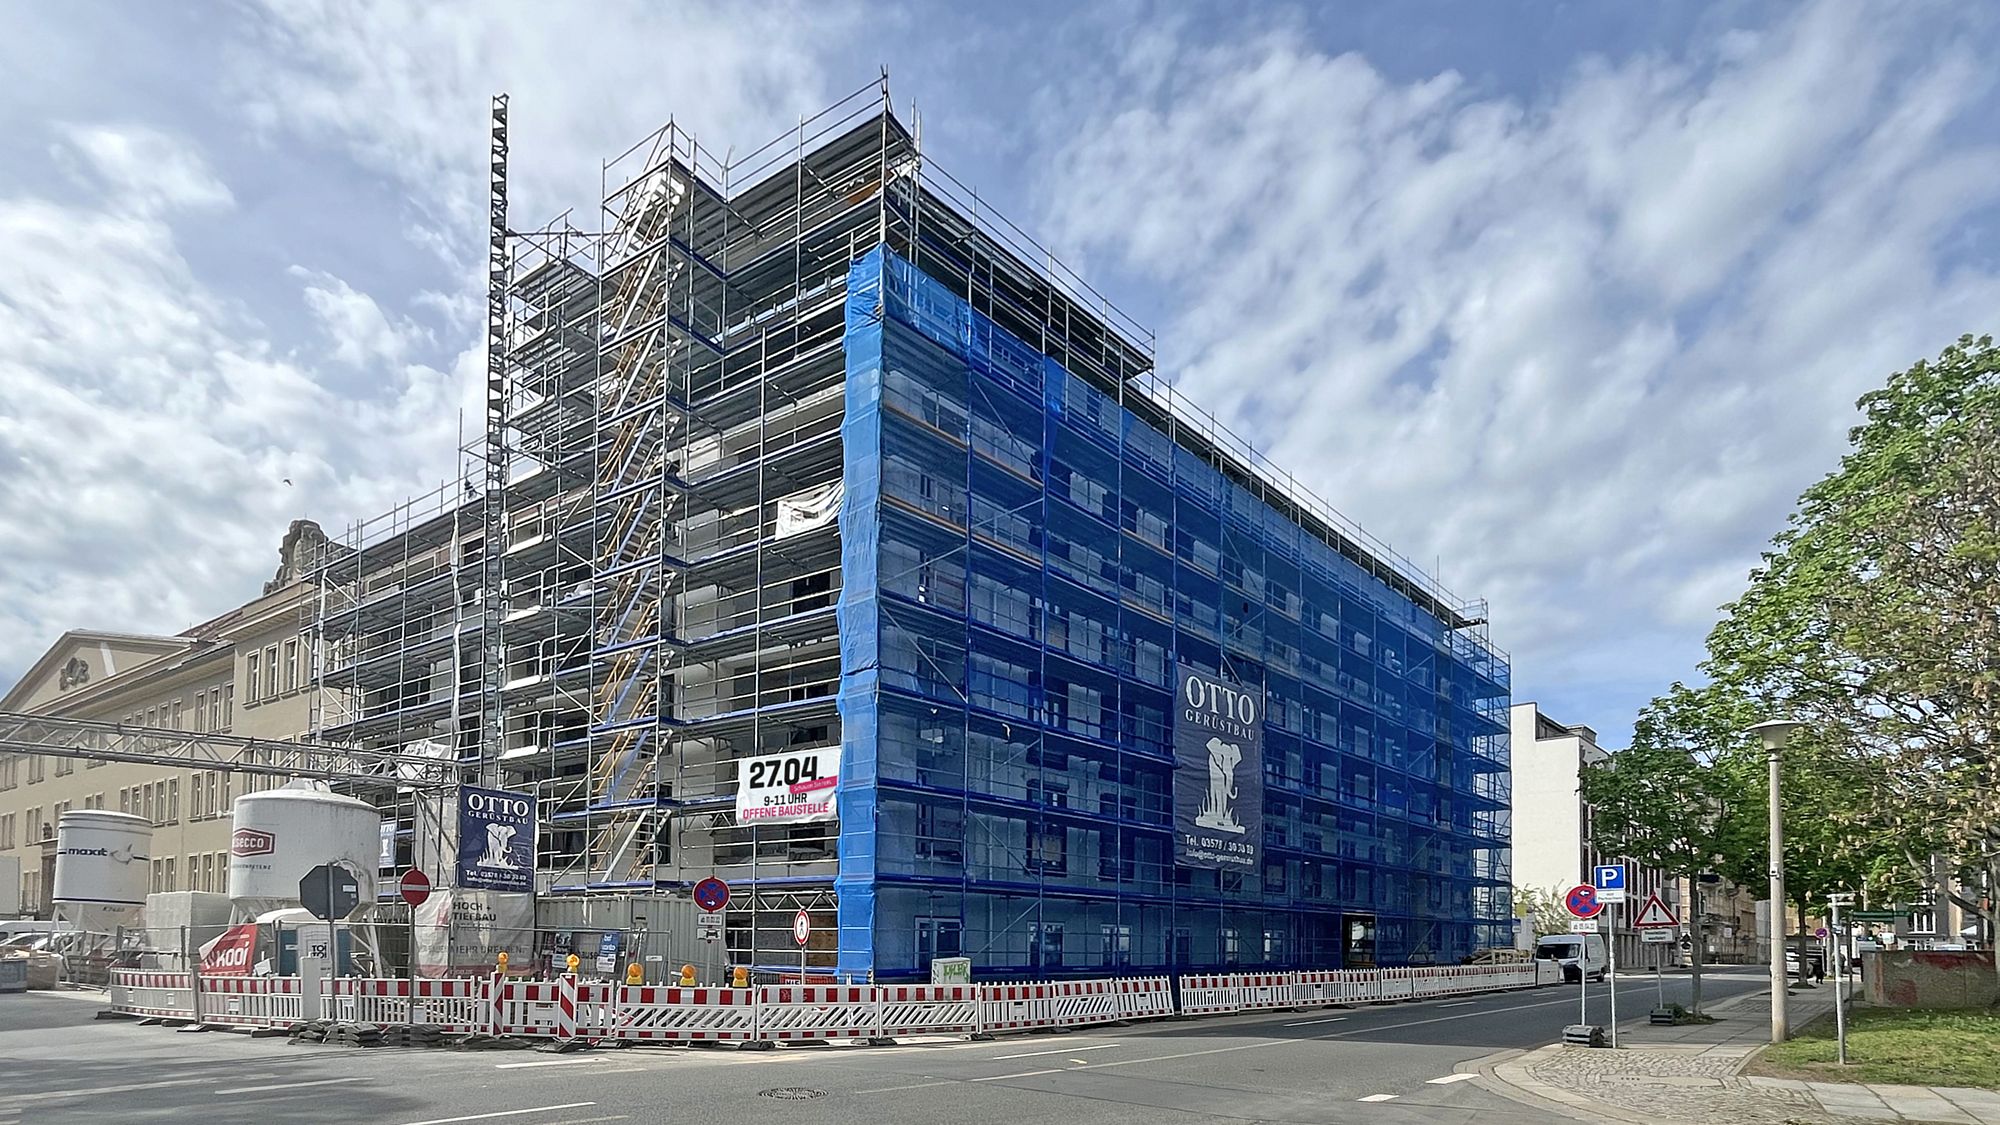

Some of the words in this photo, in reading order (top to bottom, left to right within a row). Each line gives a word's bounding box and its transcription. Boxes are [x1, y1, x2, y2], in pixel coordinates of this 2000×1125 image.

[1185, 675, 1255, 725] OTTO
[1185, 708, 1255, 741] GERÜSTBAU
[749, 755, 824, 789] 27.04.
[468, 793, 529, 817] OTTO
[763, 795, 786, 806] 9-11
[787, 793, 808, 804] UHR
[468, 810, 528, 825] GERÜSTBAU
[743, 806, 777, 820] OFFENE
[778, 802, 829, 816] BAUSTELLE
[1185, 834, 1199, 847] Tel.
[68, 848, 108, 857] maxit
[1601, 868, 1618, 888] P
[453, 901, 483, 911] HOCH
[453, 912, 497, 922] TIEFBAU
